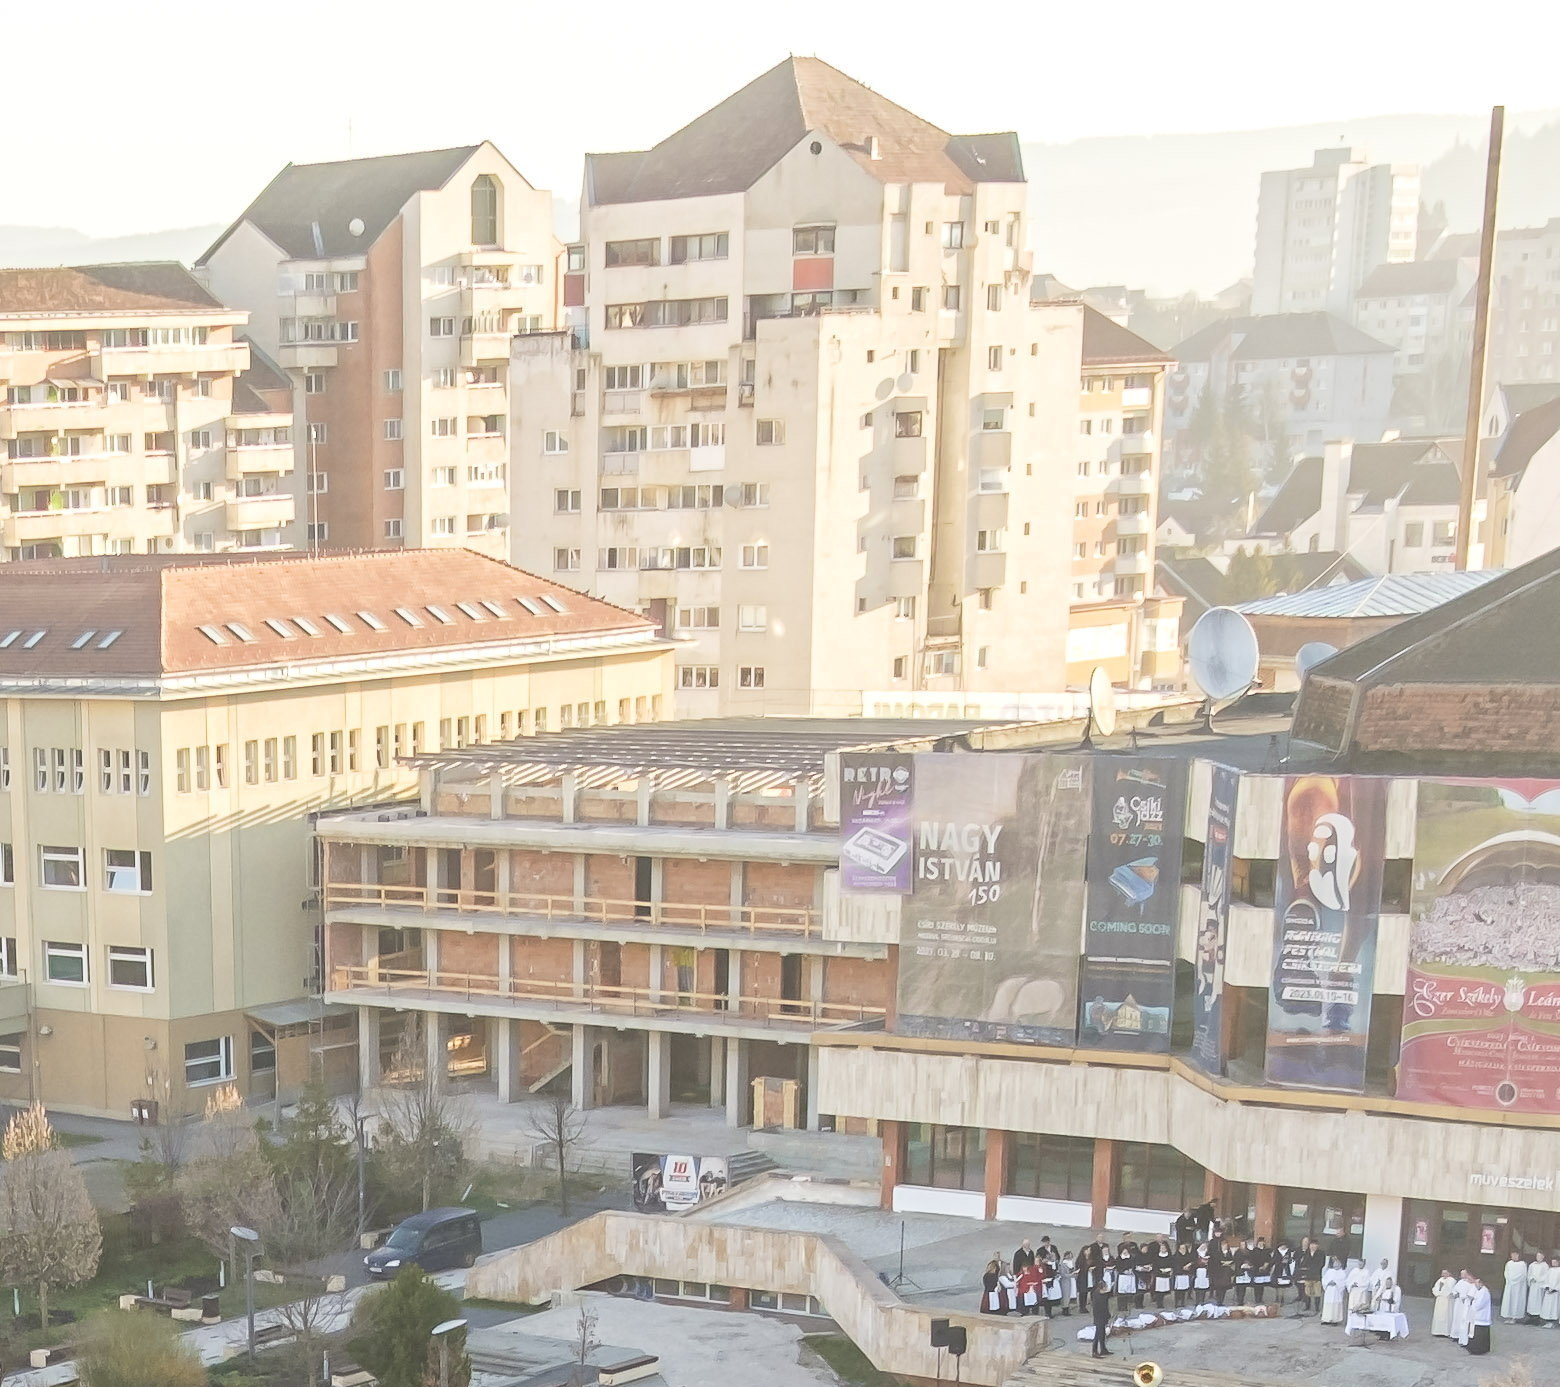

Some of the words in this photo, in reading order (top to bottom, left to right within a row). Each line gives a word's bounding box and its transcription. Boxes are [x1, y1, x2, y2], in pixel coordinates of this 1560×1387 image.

[920, 820, 1003, 854] NAGY
[918, 853, 1001, 882] ISTVÁN
[969, 884, 1001, 906] 150
[1089, 920, 1137, 934] COMING
